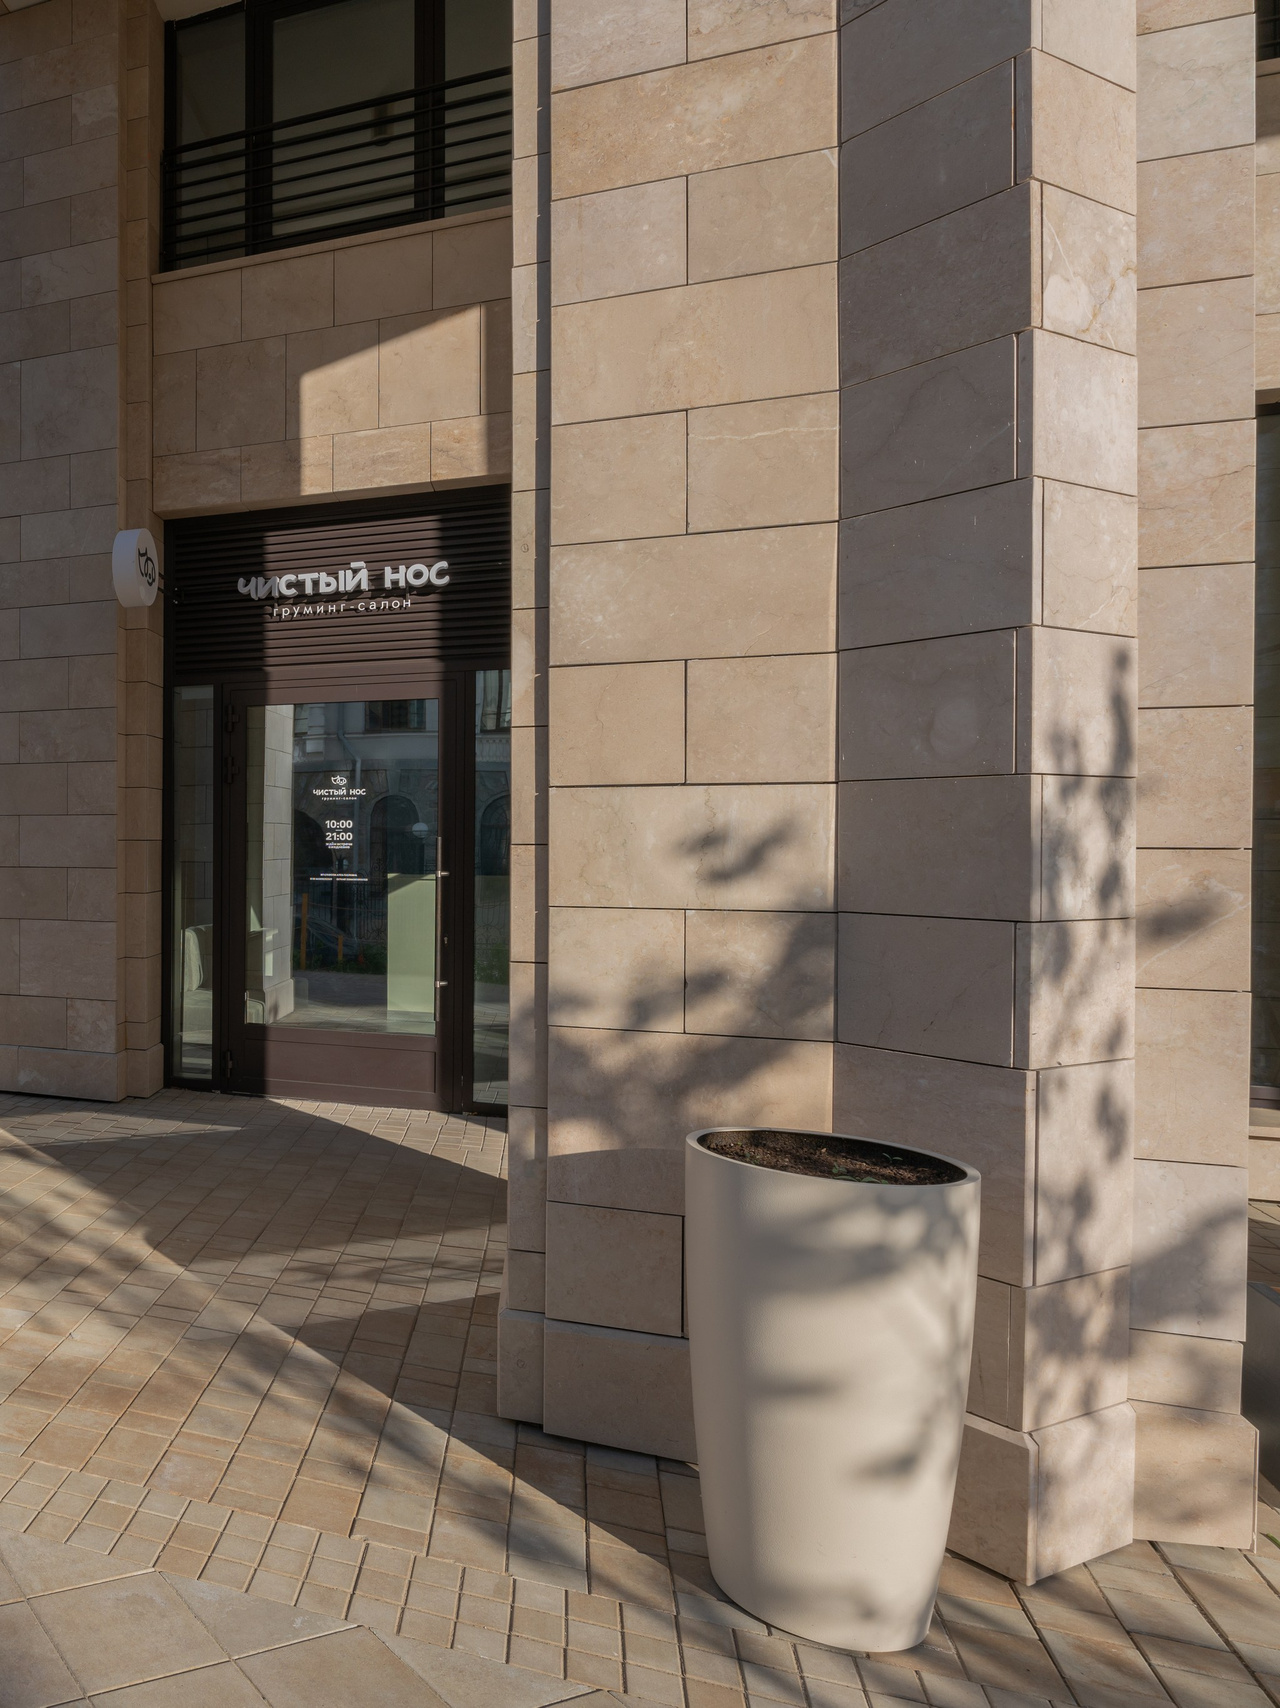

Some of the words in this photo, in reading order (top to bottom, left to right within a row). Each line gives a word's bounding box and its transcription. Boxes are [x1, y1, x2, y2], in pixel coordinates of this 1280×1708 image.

[237, 561, 369, 601] ЧИСТЫЙ
[384, 560, 450, 590] НОС
[273, 599, 412, 619] груминг-салон
[313, 787, 347, 796] ЧИСТЫЙ
[349, 788, 366, 796] НОС
[325, 820, 353, 829] 10:00
[325, 832, 353, 841] 21:00
